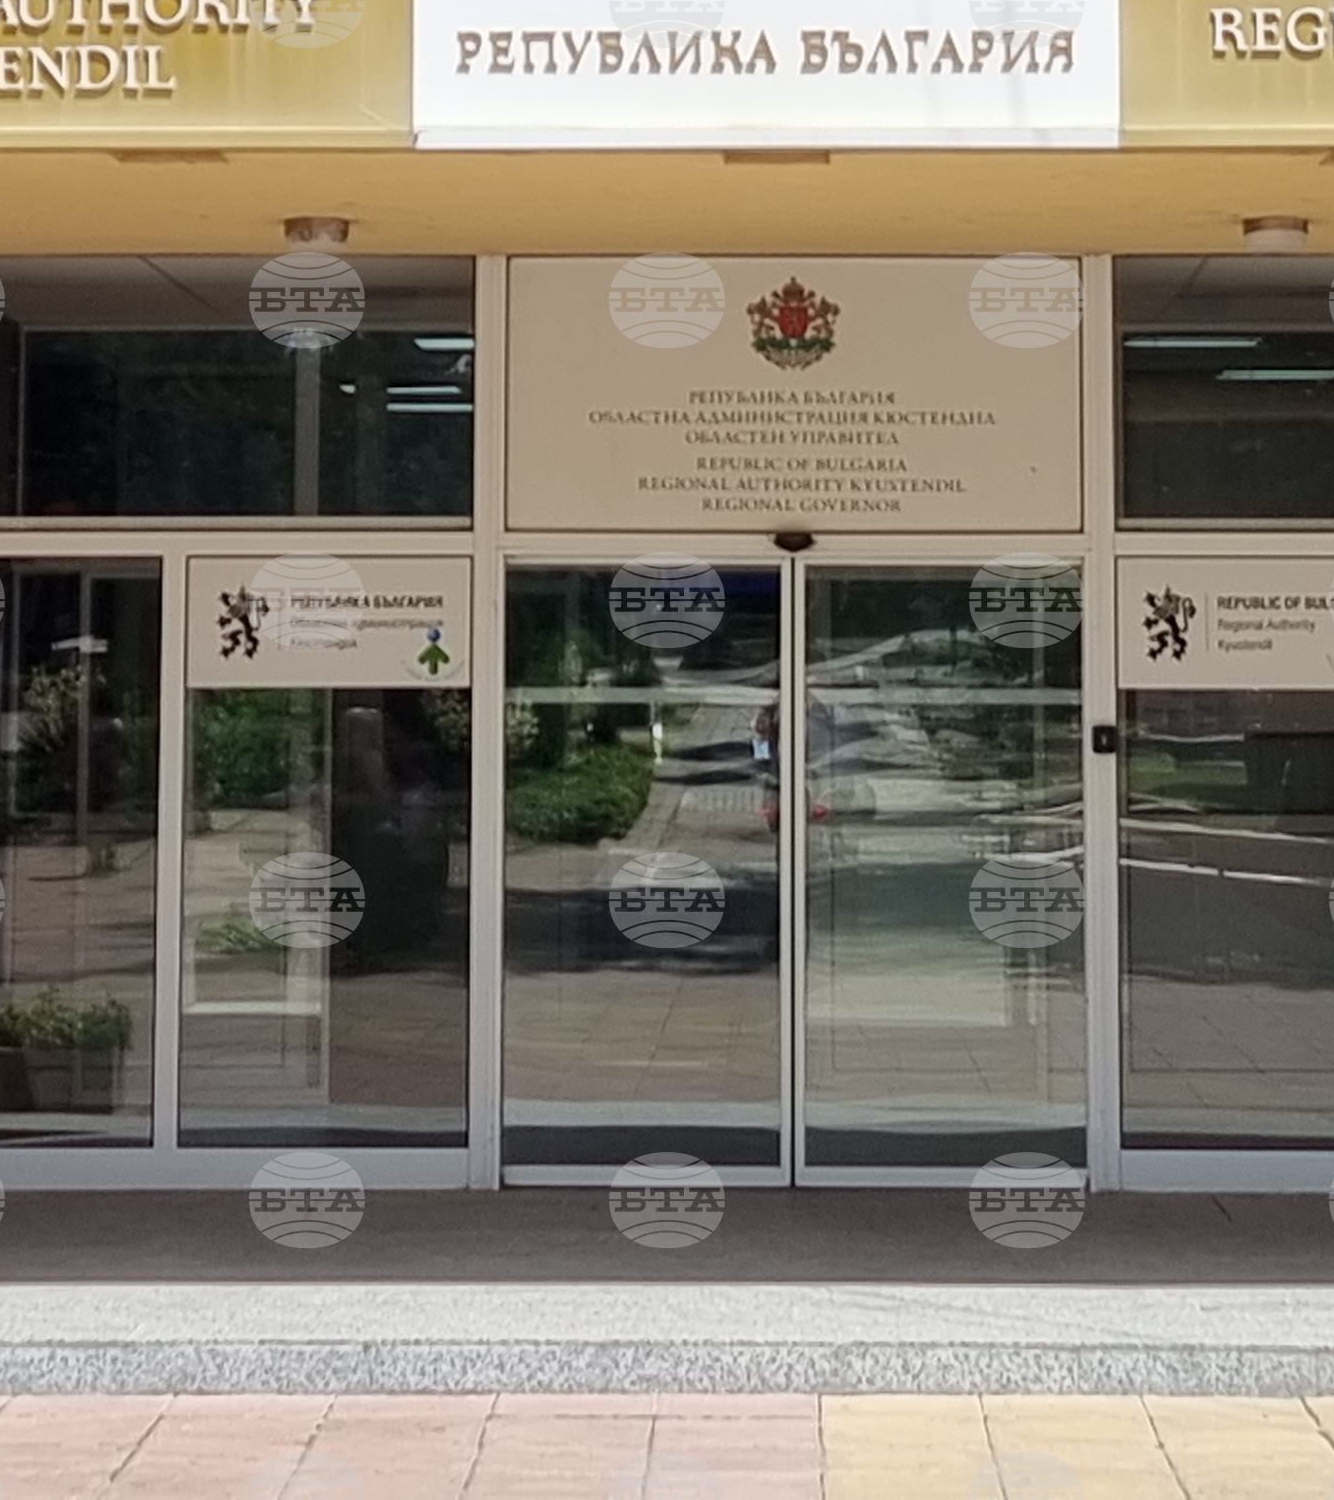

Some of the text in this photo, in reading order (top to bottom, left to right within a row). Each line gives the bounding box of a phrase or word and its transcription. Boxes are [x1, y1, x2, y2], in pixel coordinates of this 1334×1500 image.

[456, 29, 1075, 75] РЕПУБЛИКА БЪЛГАРИЯ
[689, 391, 895, 404] РЕПУБЛИКА БЪЛГАРИЯ
[589, 411, 690, 425] ОБЛАСТНА
[685, 431, 899, 445] ОБЛАСТЕН УПРАВИТЕЛ
[696, 457, 907, 471] REPUBLIC OF BULGARIA
[638, 477, 966, 492] REGIONAL AUTHORITY KYUSTENDIL
[702, 498, 900, 512] REGIONAL GOVERNOR
[1217, 597, 1280, 609] REPUBLIC
[1285, 597, 1301, 609] OF
[1266, 619, 1316, 632] Authority
